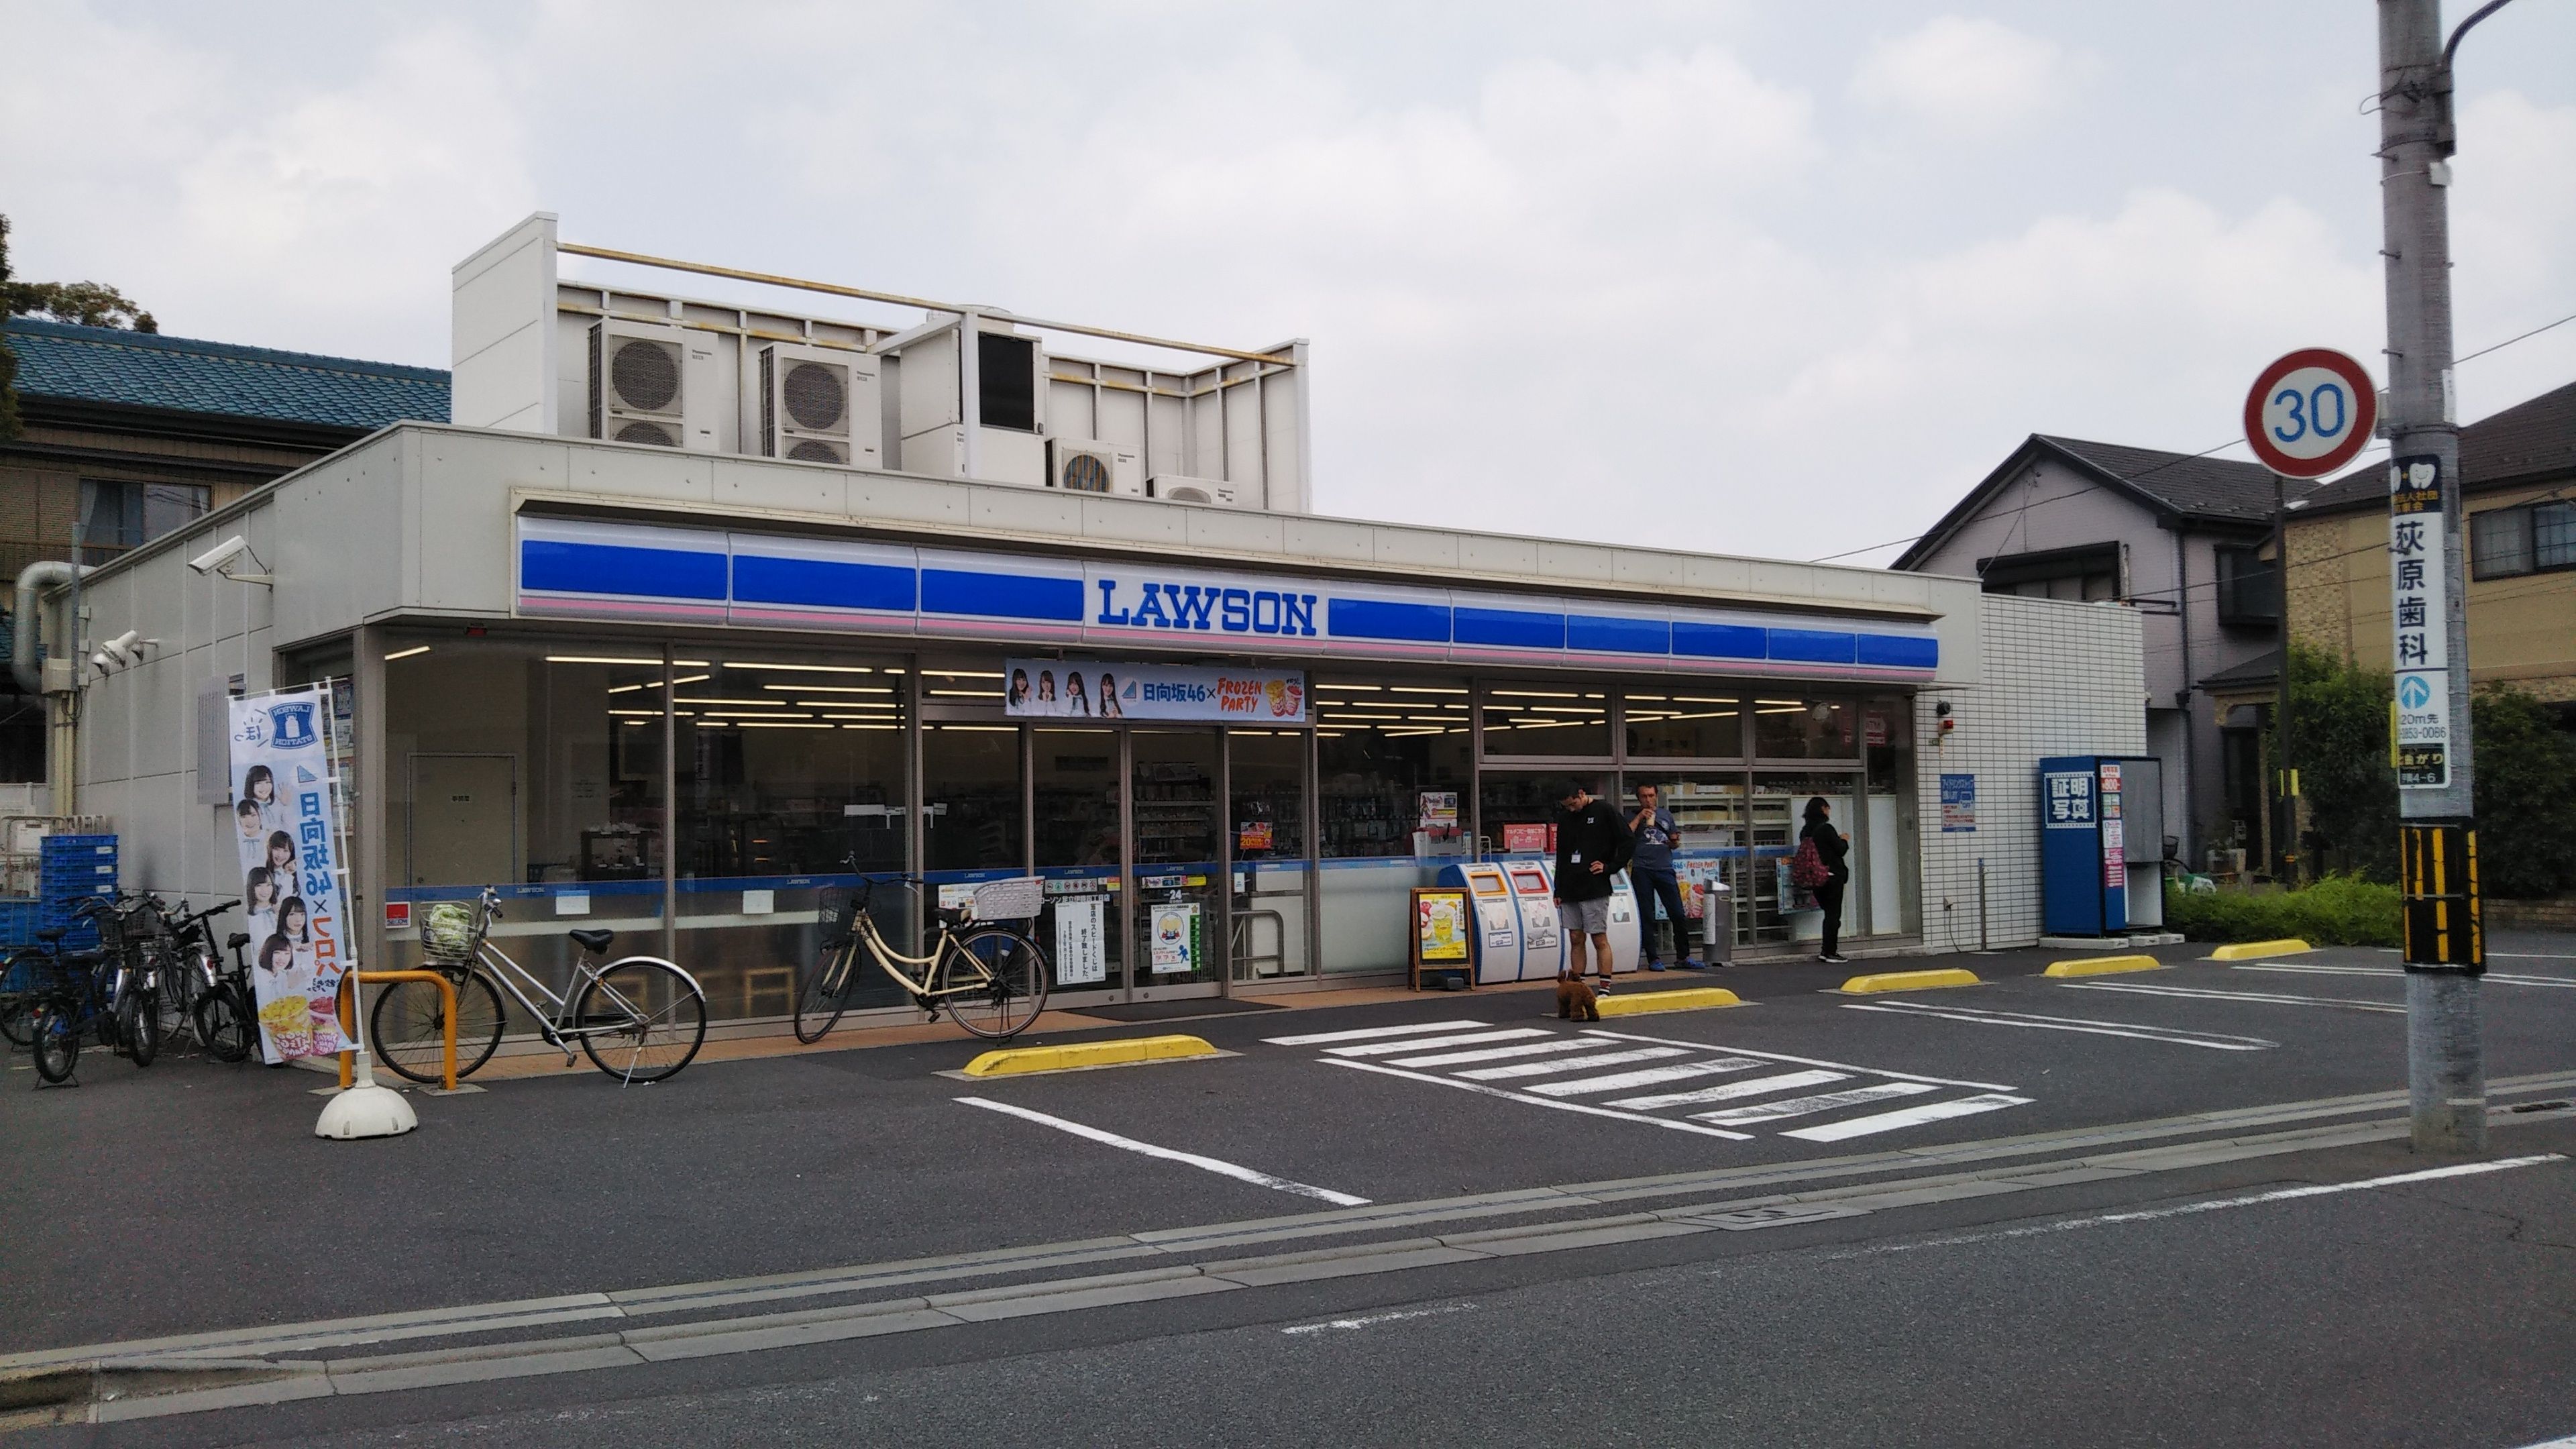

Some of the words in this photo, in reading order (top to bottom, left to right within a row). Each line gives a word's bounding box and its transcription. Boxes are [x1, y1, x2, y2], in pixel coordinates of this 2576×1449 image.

[2275, 384, 2345, 443] 30
[1099, 580, 1317, 636] LAWSON
[2396, 521, 2428, 666] 荻原歯科
[1143, 682, 1206, 702] 日向坂46
[1217, 678, 1262, 696] FROZEN
[1220, 695, 1258, 713] PARTY
[2051, 777, 2088, 798] 証明
[2053, 799, 2090, 820] 写真
[1169, 890, 1182, 900] 24
[1081, 928, 1089, 979] 終了致しました。
[1089, 903, 1098, 972] 当店のスピードくじは
